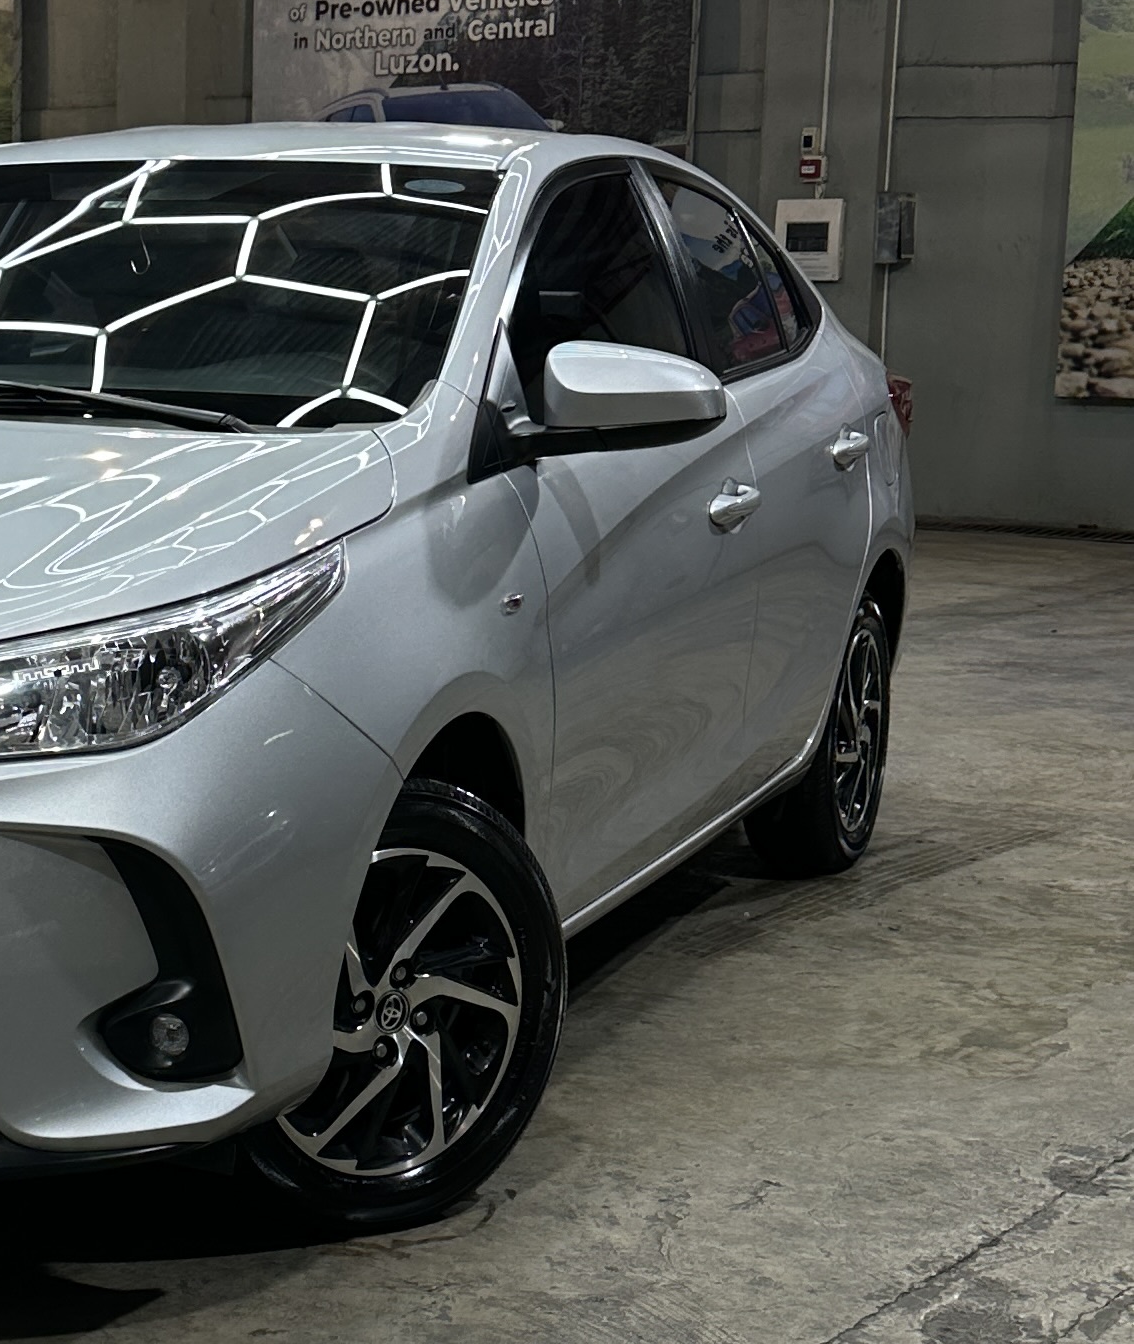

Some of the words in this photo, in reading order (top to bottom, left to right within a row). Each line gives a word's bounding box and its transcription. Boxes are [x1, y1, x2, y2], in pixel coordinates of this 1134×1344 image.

[289, 4, 307, 22] of
[293, 33, 308, 50] in
[314, 26, 416, 53] Northern
[423, 22, 456, 42] and
[467, 14, 555, 42] Central
[374, 52, 460, 77] Luzon.
